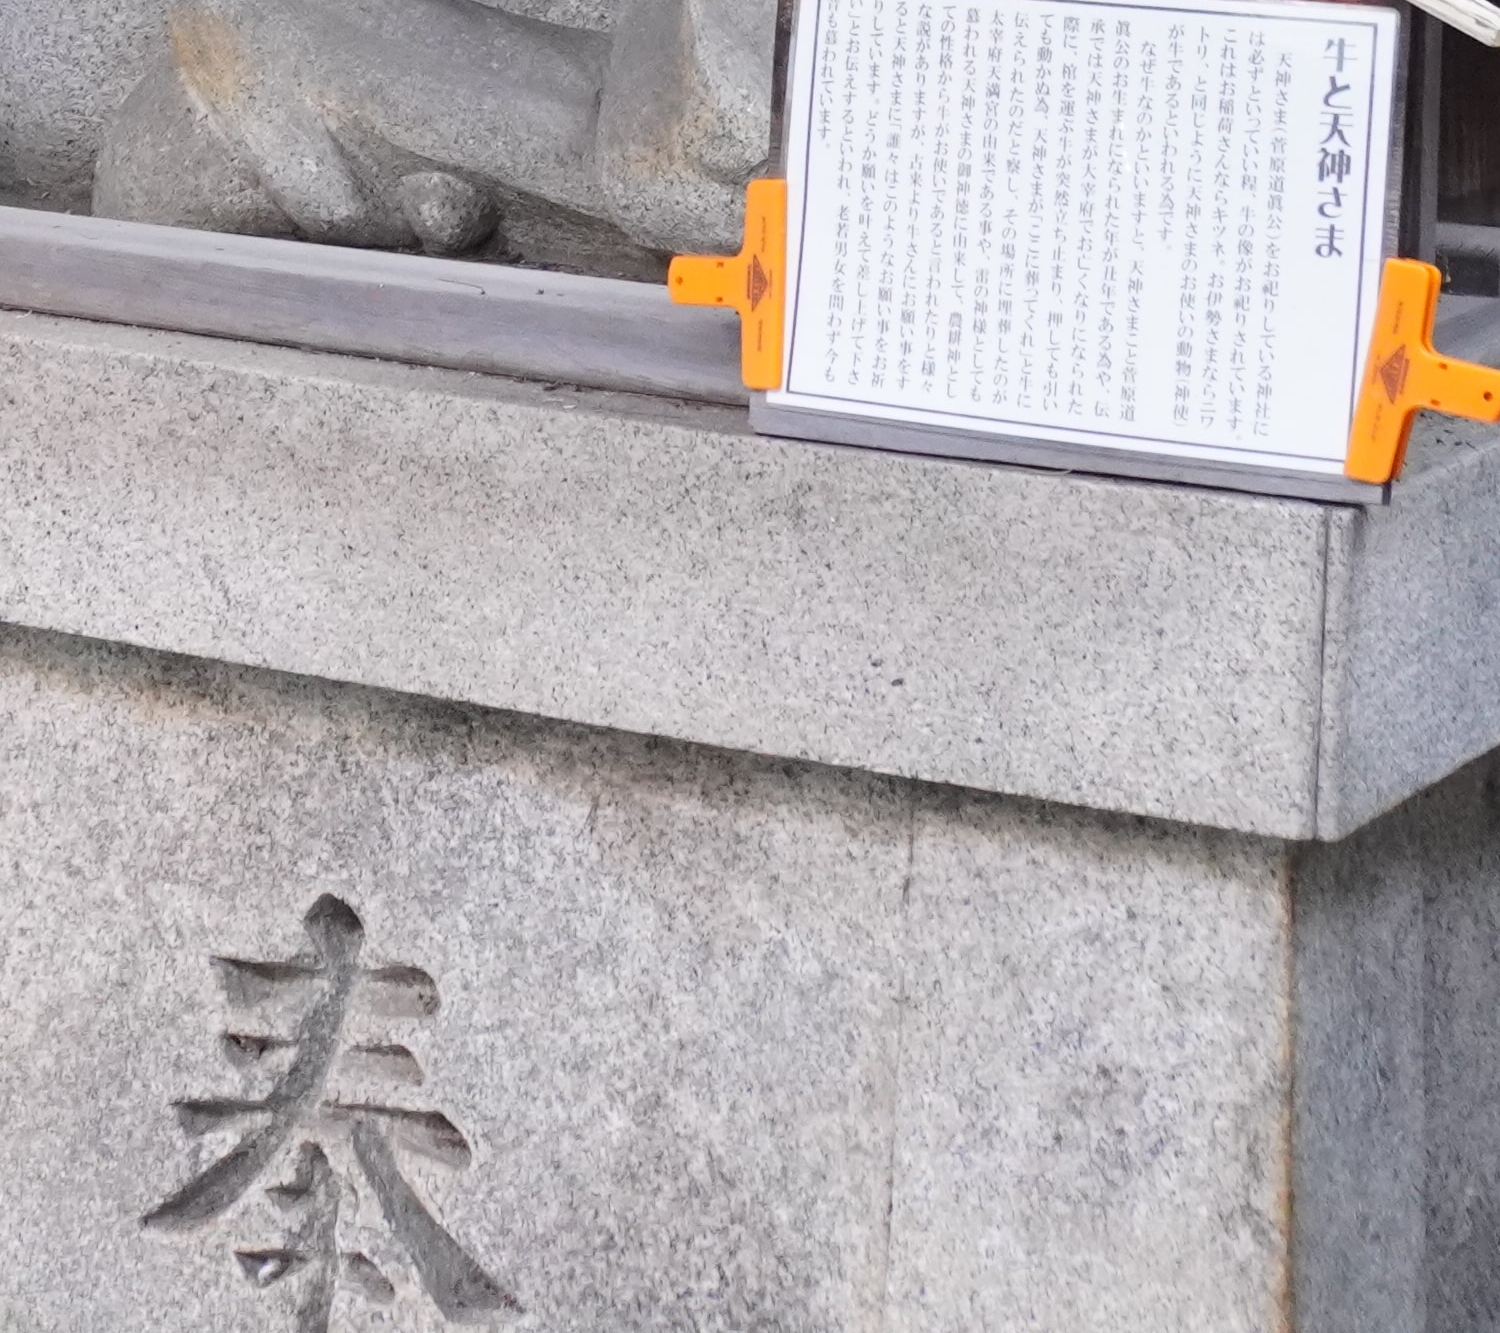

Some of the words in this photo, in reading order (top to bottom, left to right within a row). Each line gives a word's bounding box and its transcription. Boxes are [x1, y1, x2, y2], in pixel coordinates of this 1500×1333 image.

[1315, 37, 1358, 258] 牛と天神さま
